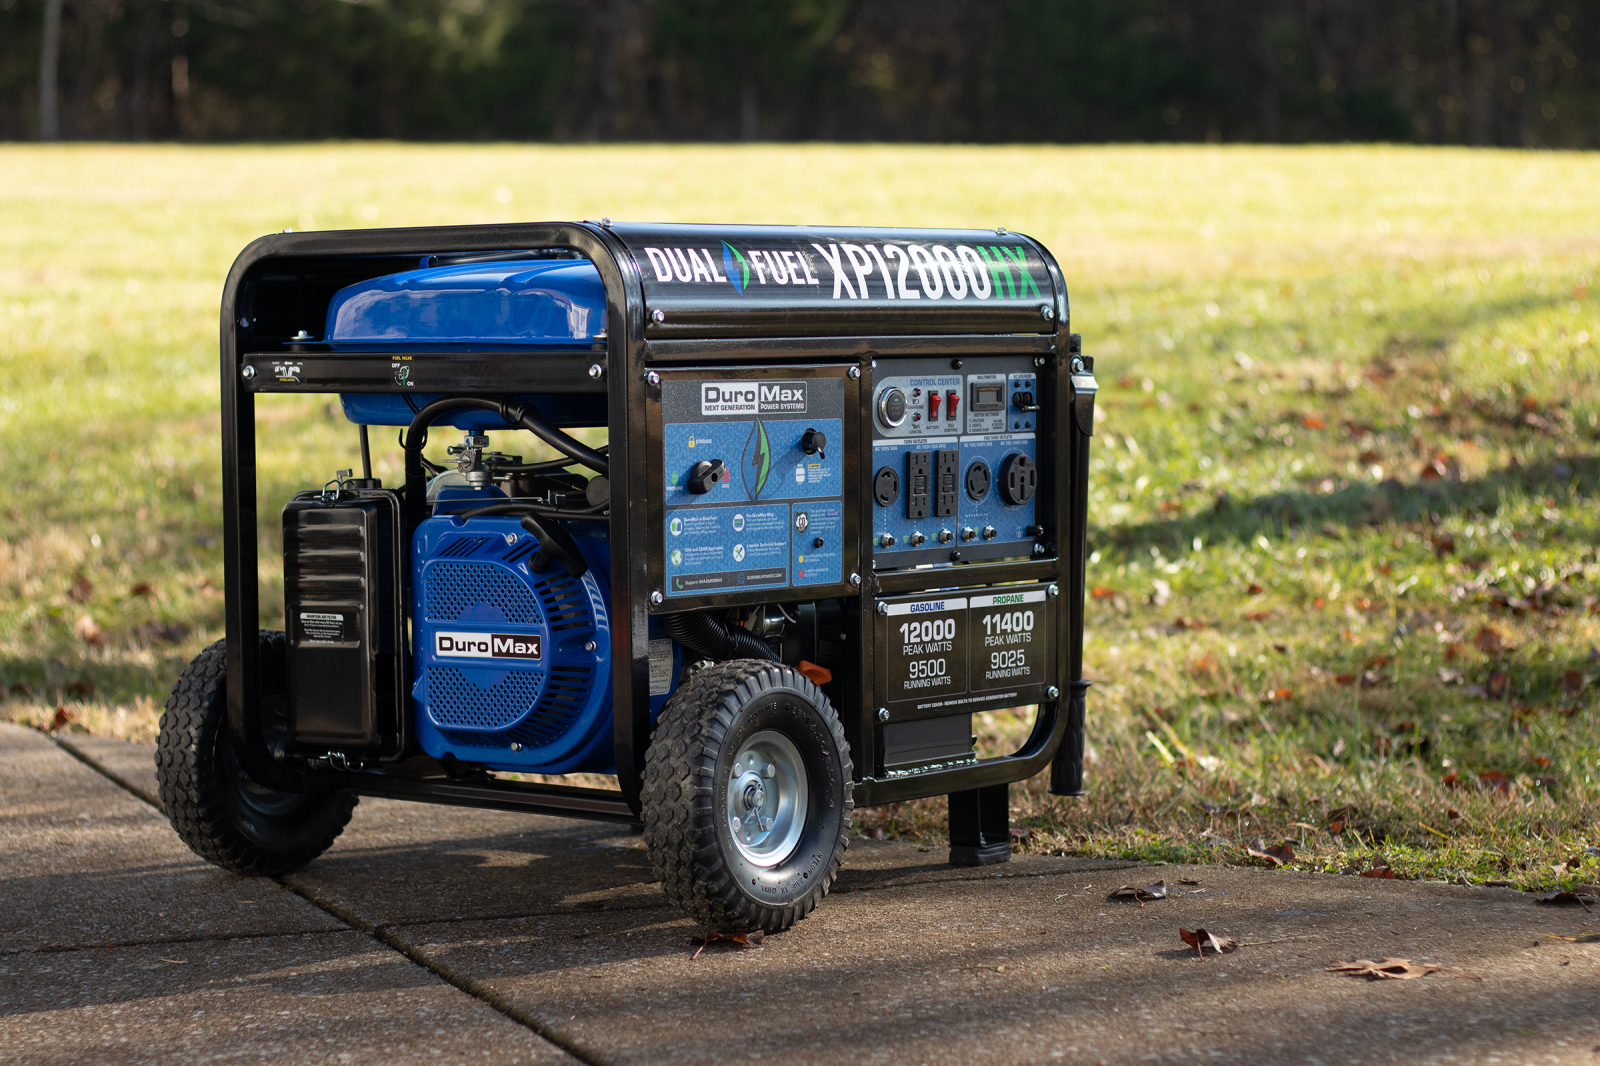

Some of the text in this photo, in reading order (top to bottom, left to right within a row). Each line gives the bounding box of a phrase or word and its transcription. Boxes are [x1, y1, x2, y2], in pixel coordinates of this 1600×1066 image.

[644, 243, 1042, 300] DUAL FUEL XP12000HX
[938, 378, 960, 386] CENTER
[910, 601, 945, 613] GASOLINE
[992, 594, 1024, 605] PROPANE
[982, 610, 1034, 635] 11400
[900, 618, 955, 644] 12000
[985, 632, 1031, 647] PEAK WATTS
[903, 641, 952, 656] PEAK WATTS
[990, 649, 1025, 669] 9025
[909, 658, 945, 679] 9500
[986, 666, 1030, 679] RUNNING WATTS
[904, 676, 951, 690] RUNNING WATTS
